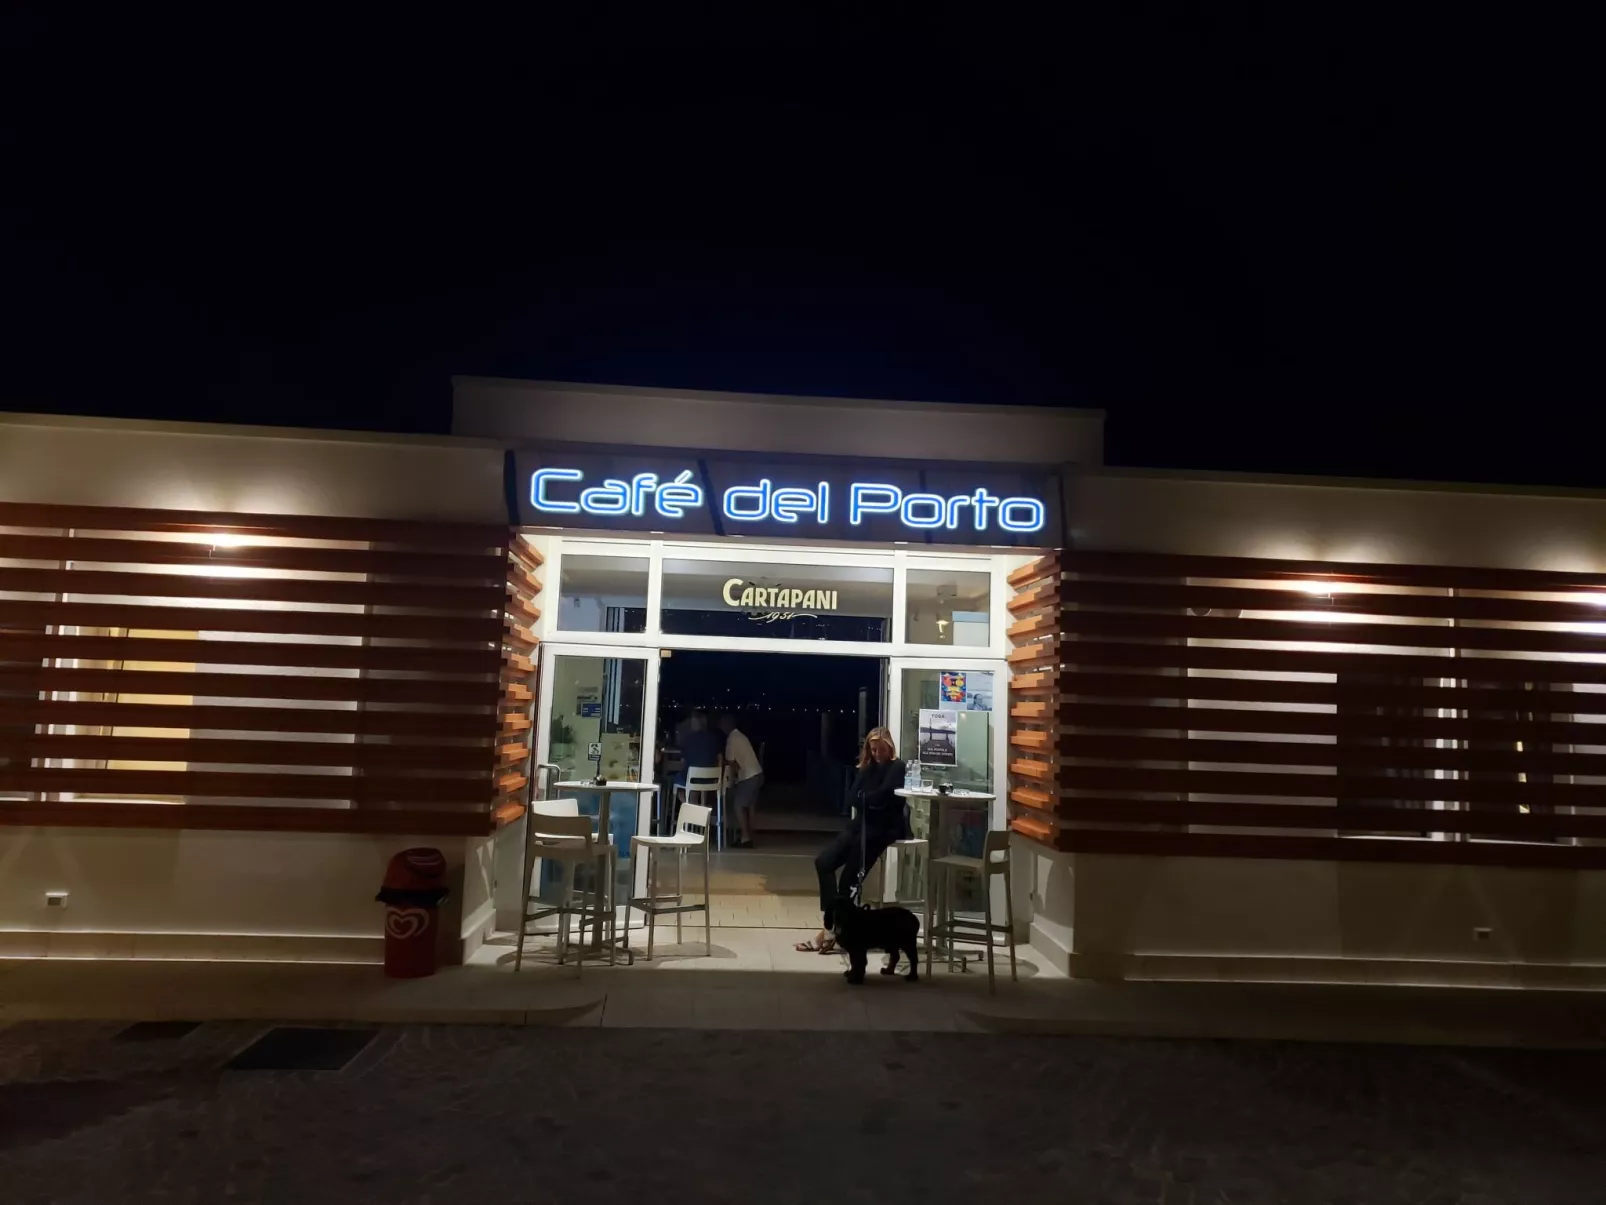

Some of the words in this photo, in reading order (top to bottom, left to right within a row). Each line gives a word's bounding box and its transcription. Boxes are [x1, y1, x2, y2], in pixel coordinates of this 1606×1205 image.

[530, 468, 702, 518] Café
[723, 478, 829, 523] del
[849, 483, 1046, 533] Porto
[722, 578, 838, 610] CARTAPANI
